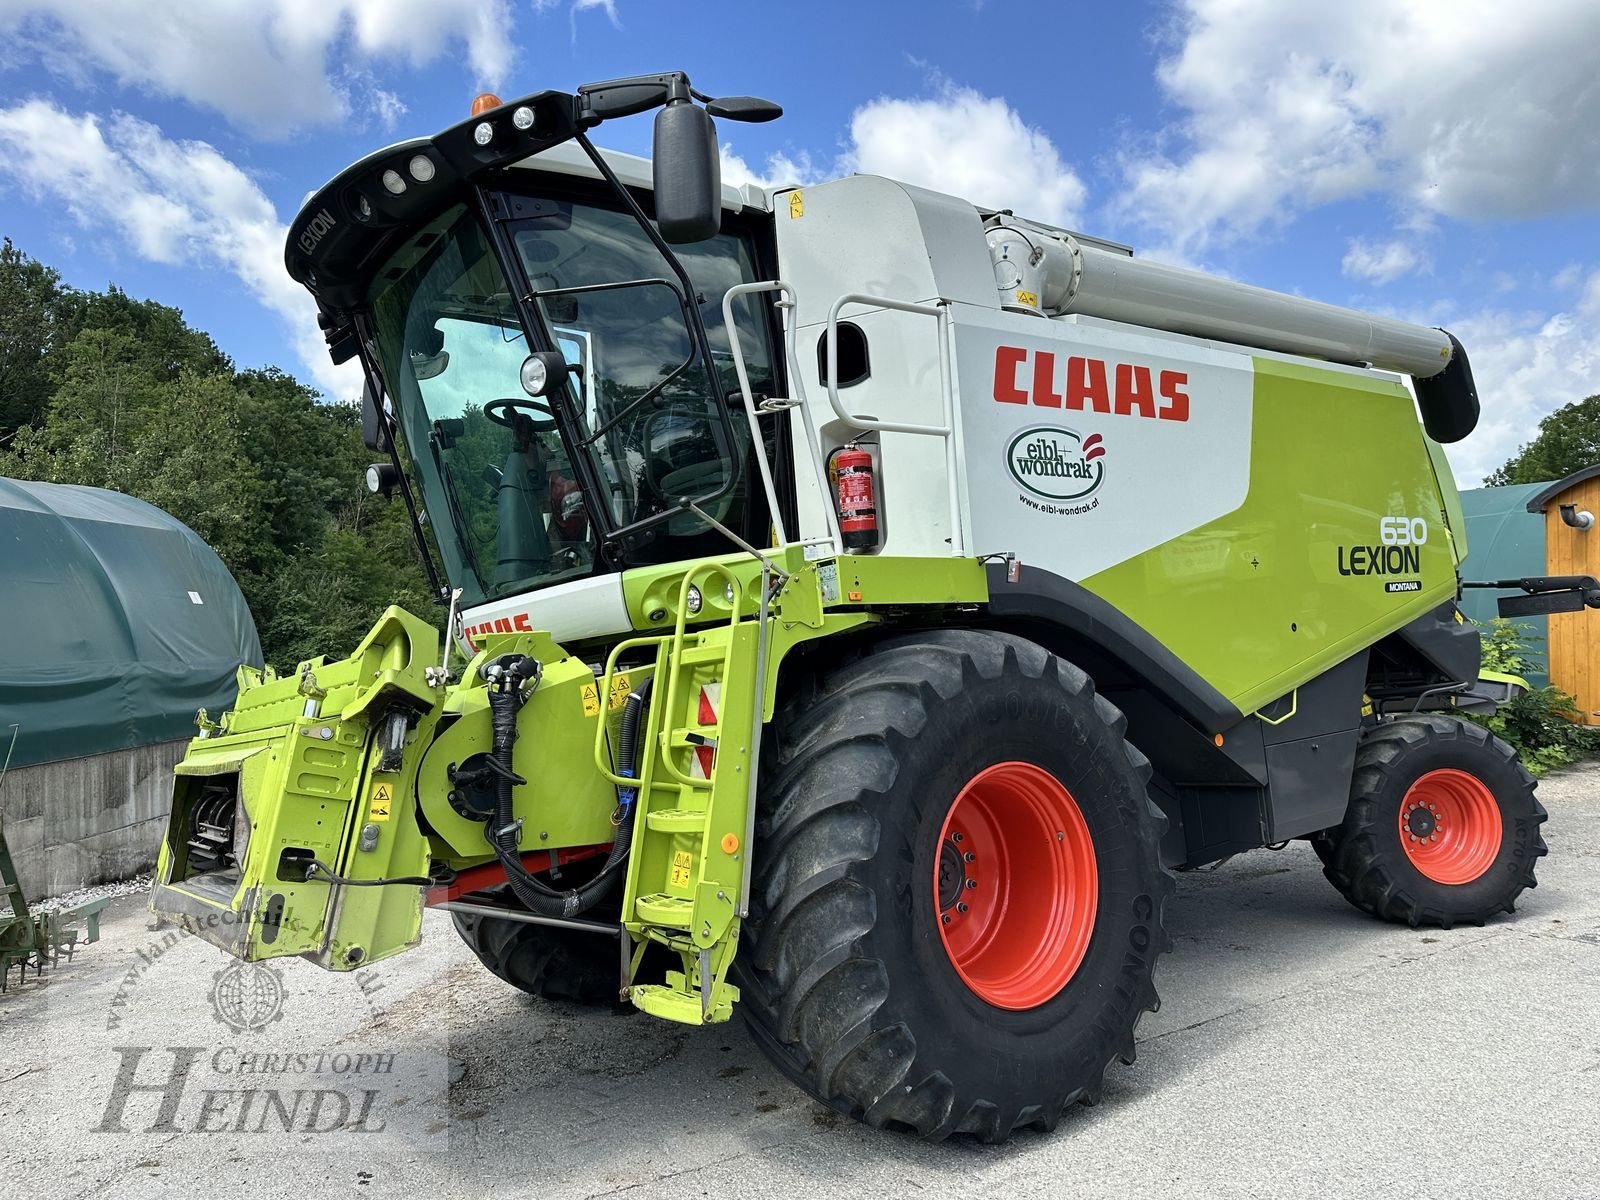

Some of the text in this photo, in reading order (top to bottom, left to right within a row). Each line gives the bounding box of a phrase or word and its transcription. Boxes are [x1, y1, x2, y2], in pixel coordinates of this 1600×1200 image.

[297, 208, 337, 256] LEXION
[993, 345, 1190, 422] CLAAS
[1016, 454, 1094, 479] wondrak
[1018, 494, 1100, 516] www.eibl-wondrak.at
[1380, 516, 1428, 546] 630
[1337, 545, 1420, 576] LEXION
[1389, 582, 1419, 592] MONTANA
